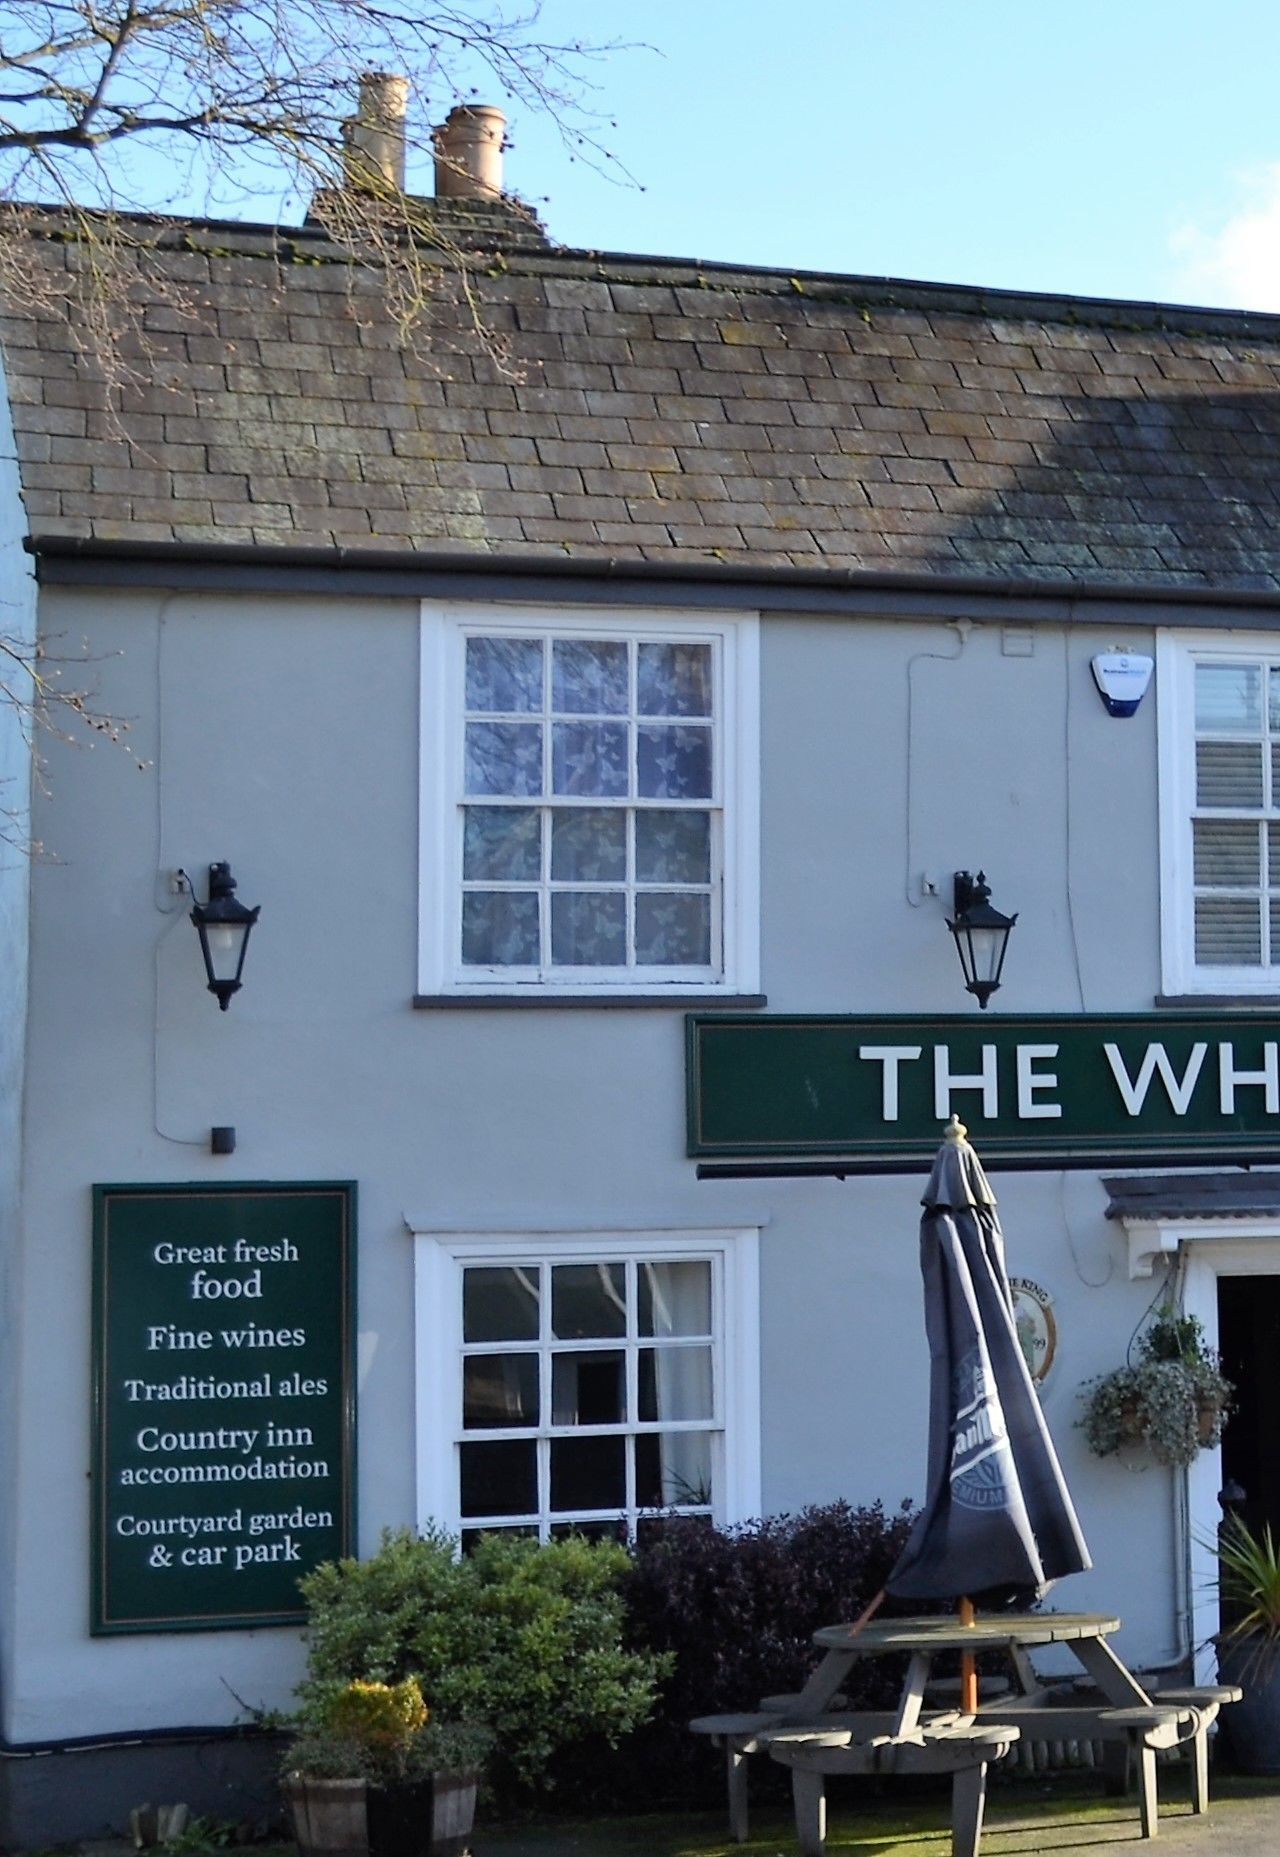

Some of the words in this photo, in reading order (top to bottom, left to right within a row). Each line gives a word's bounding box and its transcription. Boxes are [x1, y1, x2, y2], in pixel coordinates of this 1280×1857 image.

[859, 1044, 1062, 1121] THE
[153, 1242, 227, 1265] Great
[233, 1237, 299, 1263] fresh
[191, 1268, 263, 1300] food
[147, 1325, 213, 1351] Fine
[220, 1322, 306, 1348] wines
[124, 1374, 272, 1402] Traditional
[278, 1372, 328, 1397] ales
[136, 1427, 260, 1455] Country
[266, 1421, 314, 1447] inn
[120, 1454, 329, 1486] accommodation
[116, 1508, 243, 1539] Courtyard
[248, 1505, 333, 1536] garden
[148, 1544, 174, 1568] &
[180, 1546, 228, 1567] car
[235, 1536, 302, 1571] park
